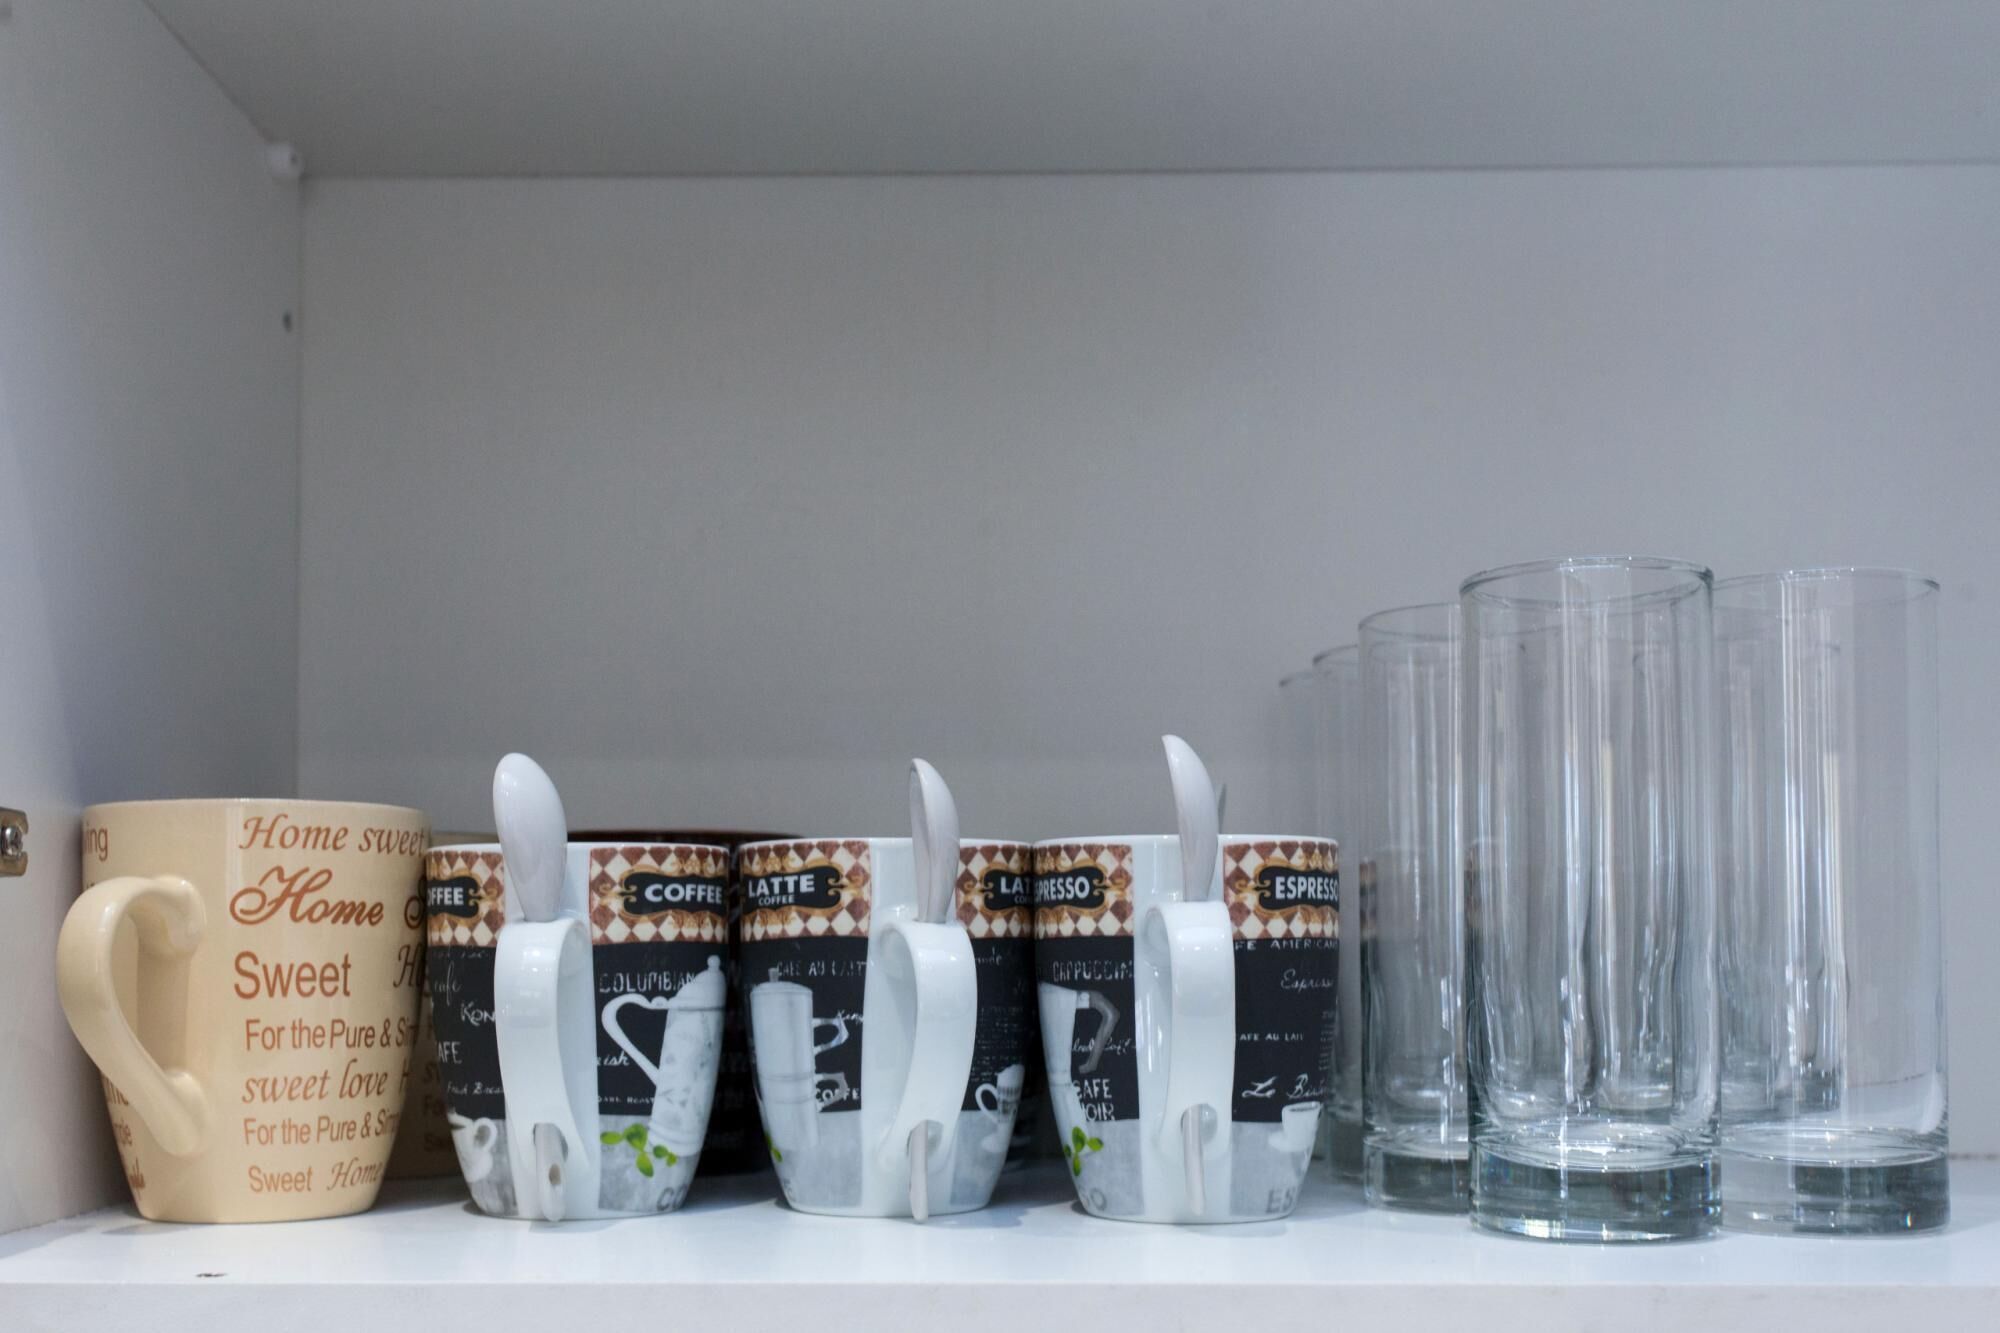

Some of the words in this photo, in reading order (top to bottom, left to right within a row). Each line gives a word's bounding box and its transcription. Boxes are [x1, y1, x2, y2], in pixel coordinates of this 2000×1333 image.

[239, 814, 348, 851] Home
[230, 865, 384, 925] Home
[644, 883, 722, 904] COFFEE
[749, 874, 815, 897] LATTE
[758, 894, 795, 906] COFFEE
[234, 951, 351, 999] Sweet
[245, 1019, 283, 1051] For
[291, 1020, 325, 1048] the
[330, 1022, 376, 1049] Pure
[380, 1018, 391, 1048] &
[242, 1068, 331, 1103] sweet
[339, 1059, 388, 1100] love
[244, 1118, 274, 1146] For
[281, 1119, 311, 1145] the
[316, 1117, 357, 1144] Pure
[360, 1112, 371, 1138] &
[249, 1165, 313, 1193] Sweet
[326, 1159, 382, 1192] Home
